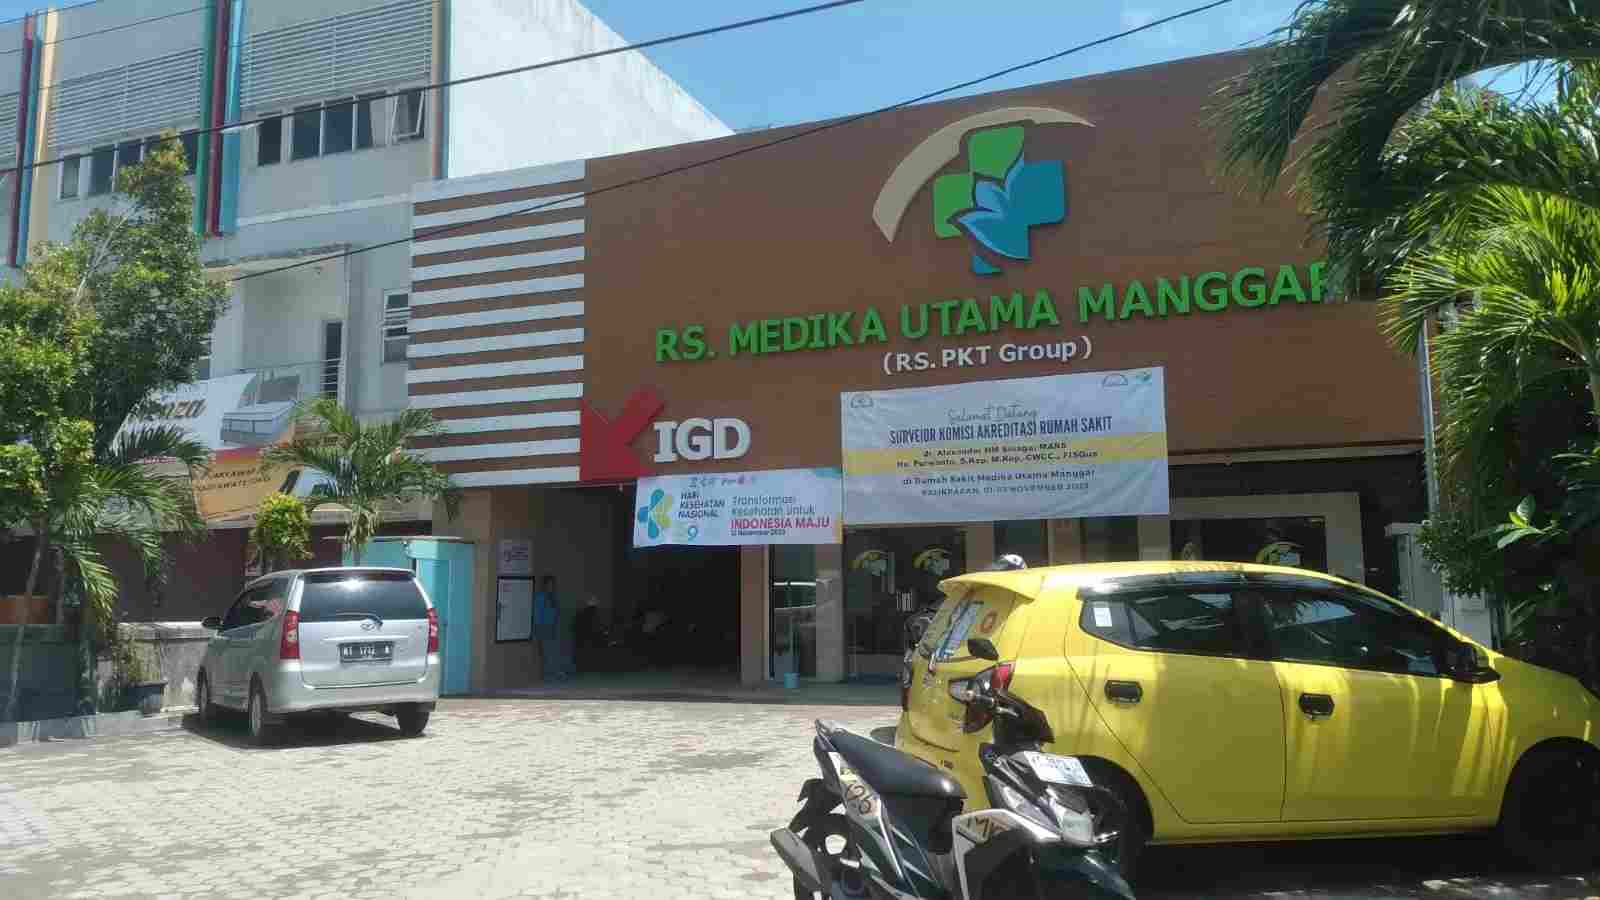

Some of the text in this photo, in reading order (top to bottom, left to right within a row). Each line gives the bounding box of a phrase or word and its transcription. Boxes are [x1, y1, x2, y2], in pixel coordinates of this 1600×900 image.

[655, 324, 718, 362] RS.
[728, 306, 889, 356] MEDIKA
[900, 288, 1060, 339] UTAMA
[941, 345, 992, 368] PKT
[939, 423, 975, 441] KOMISI
[977, 419, 1037, 440] AKREDITASI
[1040, 417, 1079, 434] RUMAH
[1080, 415, 1112, 433] SAKIT
[653, 417, 751, 463] IGD
[679, 499, 725, 509] KESEHATAN
[785, 504, 816, 516] untuk
[678, 509, 720, 519] NASIONAL
[730, 515, 830, 529] INDONESIA MAJU
